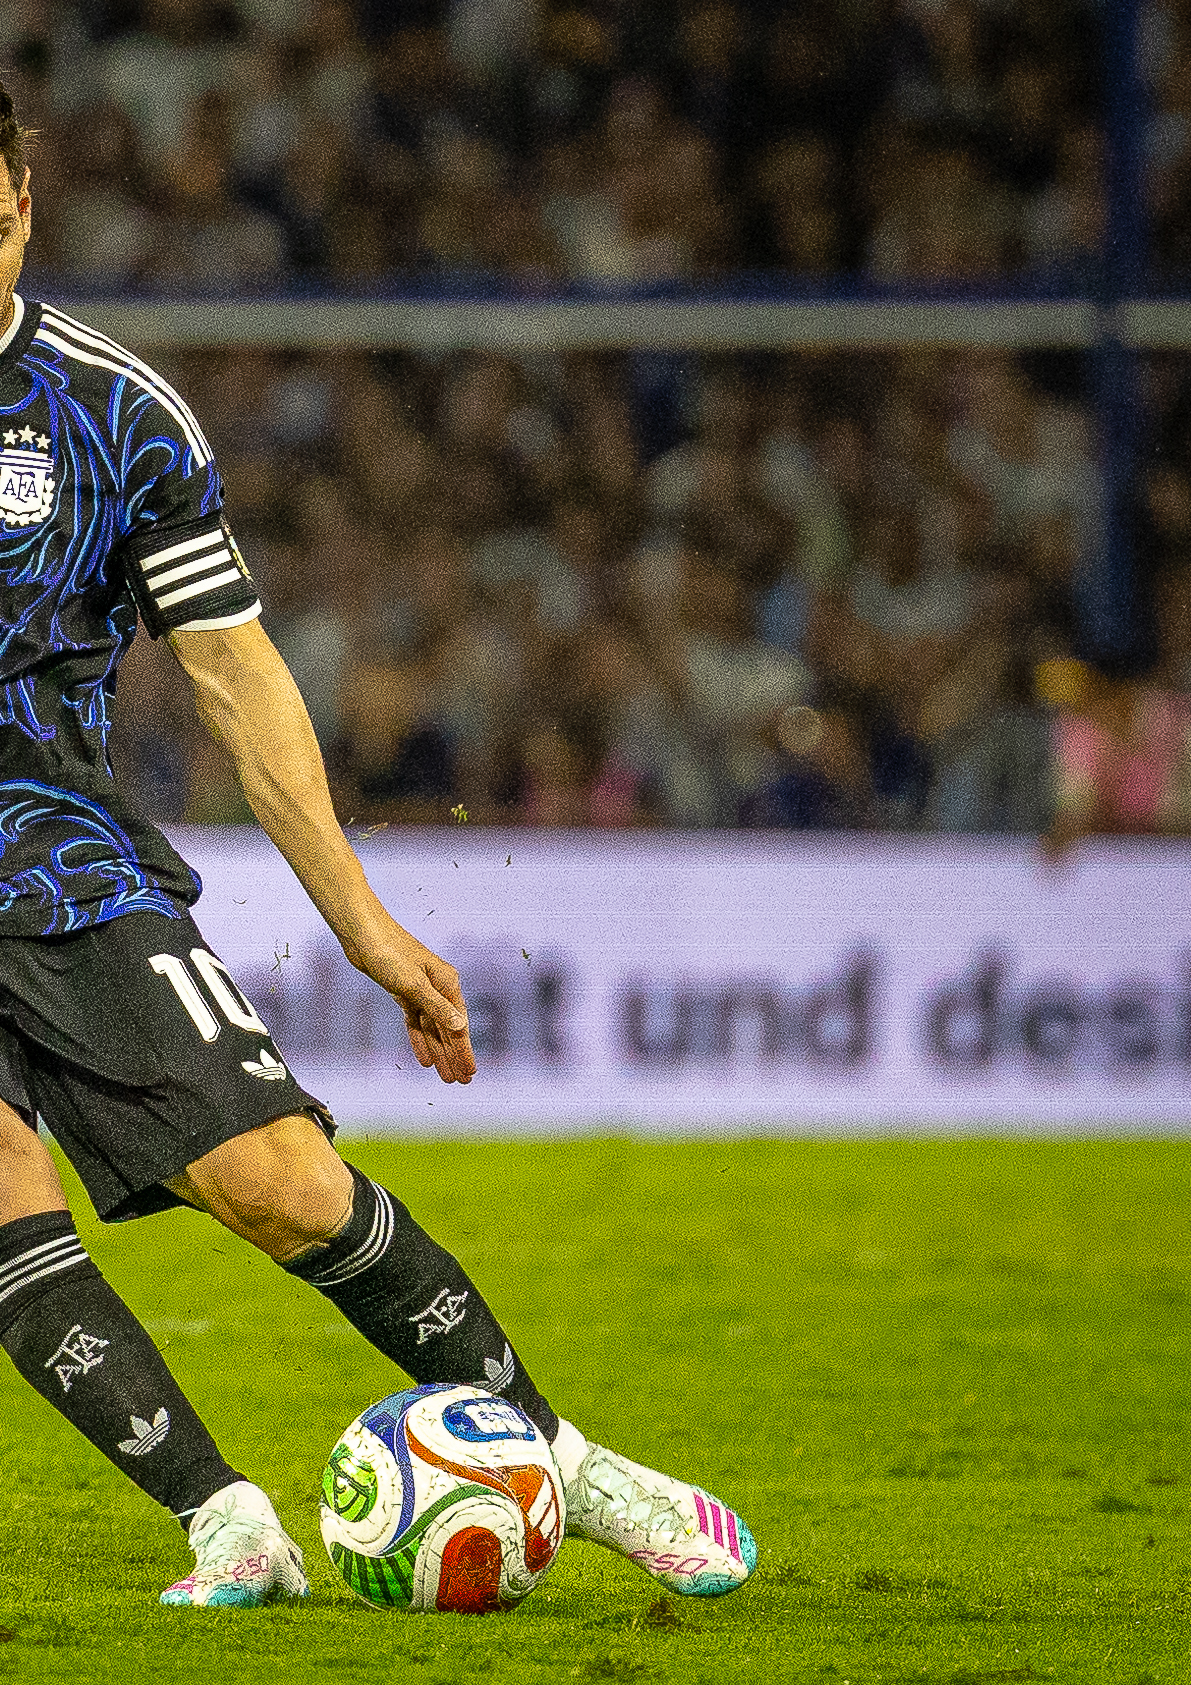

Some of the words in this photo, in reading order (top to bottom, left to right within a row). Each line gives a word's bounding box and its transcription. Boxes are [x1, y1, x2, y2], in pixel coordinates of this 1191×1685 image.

[2, 468, 38, 503] AFA
[147, 948, 270, 1043] 10
[616, 938, 884, 1080] und
[409, 1287, 468, 1345] AFA
[44, 1323, 110, 1393] AFA
